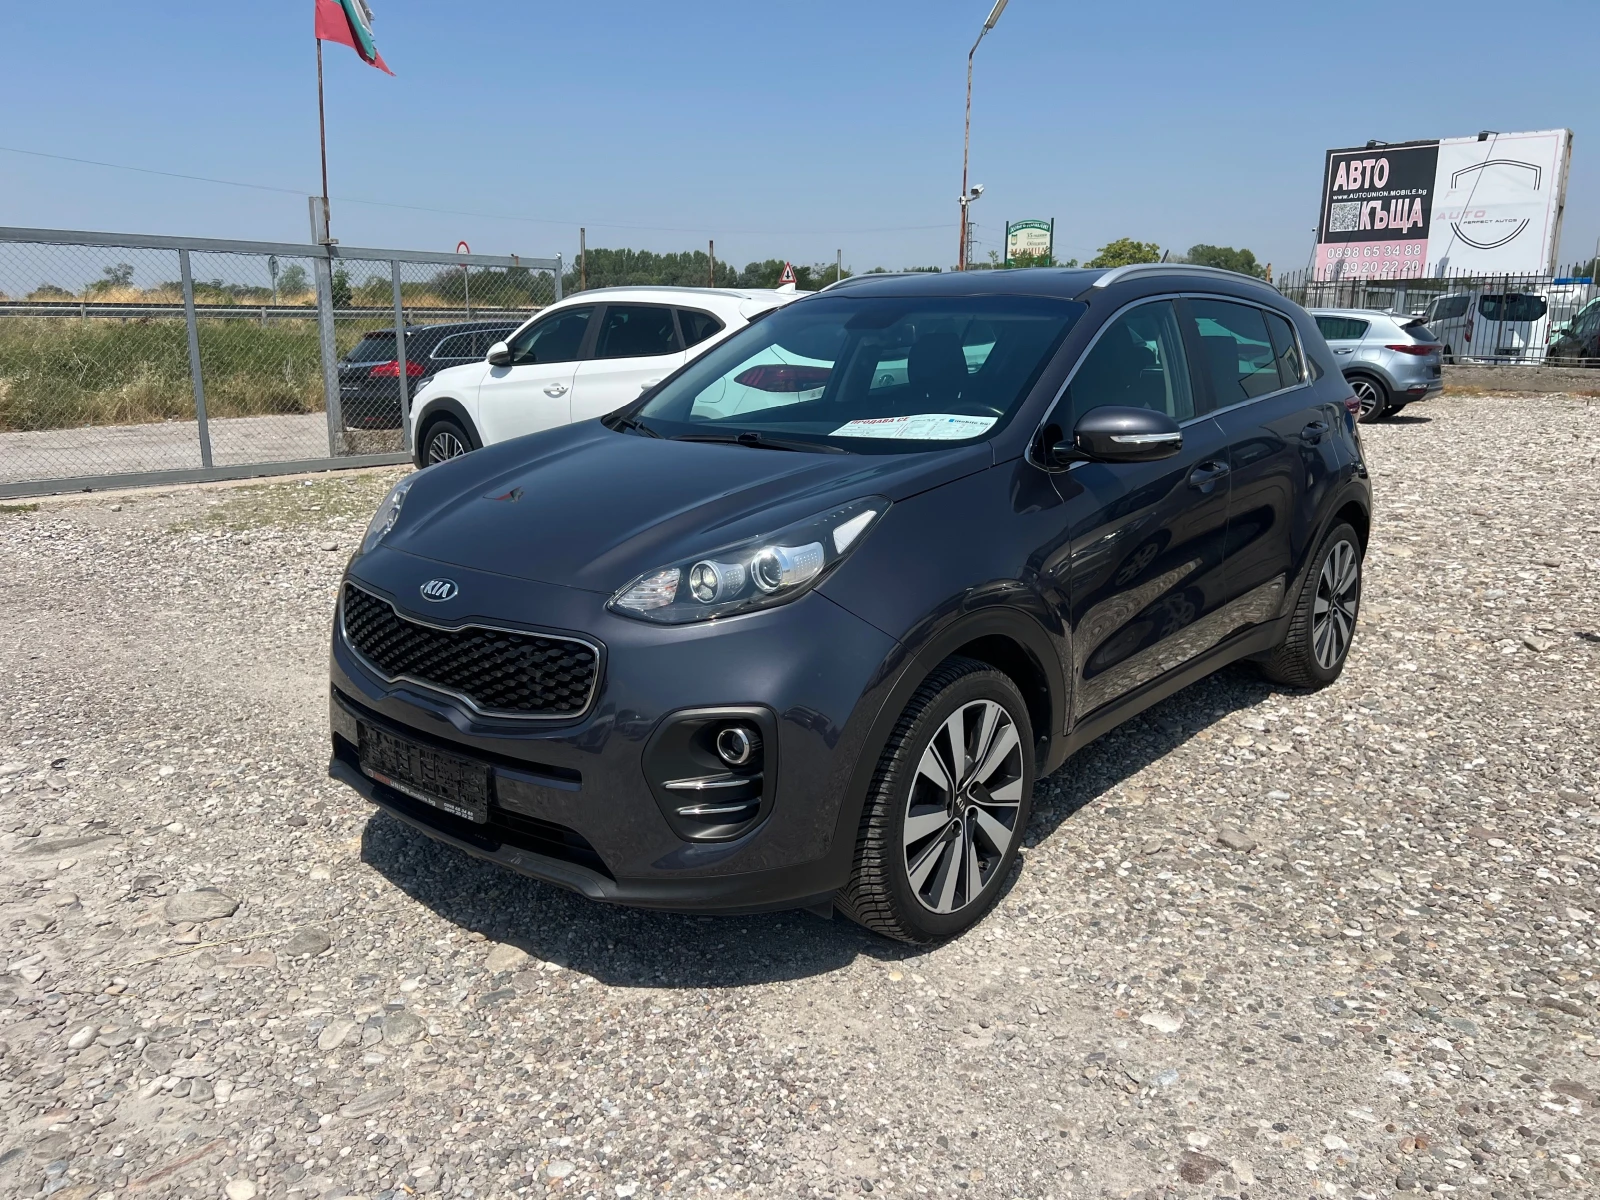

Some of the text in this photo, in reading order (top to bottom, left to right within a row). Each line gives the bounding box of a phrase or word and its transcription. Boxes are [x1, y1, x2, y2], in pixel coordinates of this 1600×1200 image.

[1333, 158, 1389, 191] АВТО
[1359, 198, 1423, 234] КЪЩА
[1436, 210, 1486, 220] AUTO
[1327, 244, 1422, 259] 0898 65 34 88
[1325, 260, 1420, 274] 0899 20 22 20
[424, 580, 451, 598] KIA
[956, 796, 965, 812] KIA
